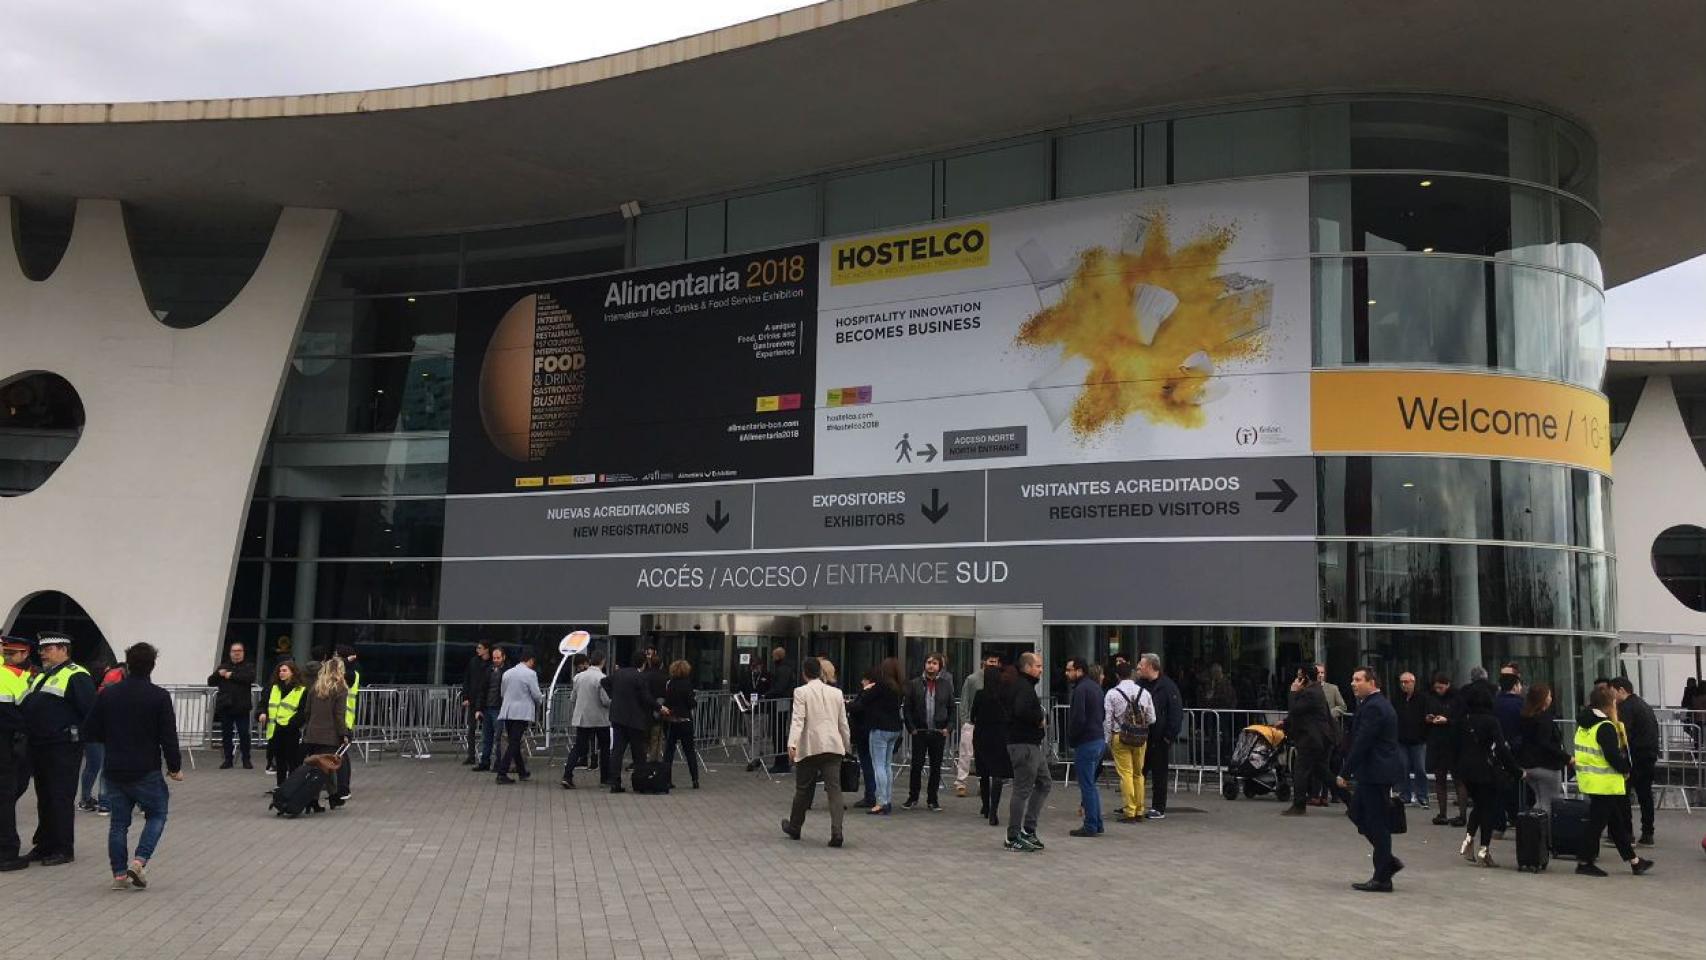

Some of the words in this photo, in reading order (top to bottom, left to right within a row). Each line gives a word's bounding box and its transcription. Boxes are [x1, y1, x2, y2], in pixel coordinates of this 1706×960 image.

[838, 229, 984, 271] HOSTELCO
[604, 266, 740, 307] Alimentaria
[746, 255, 804, 288] 2018
[604, 309, 649, 322] International
[675, 303, 700, 314] Drinks
[701, 301, 707, 310] &
[708, 298, 729, 308] Food
[731, 294, 760, 305] Service
[762, 289, 803, 301] Exhibition
[836, 310, 906, 328] HOSPITALITY
[909, 302, 981, 319] INNOVATION
[836, 325, 903, 344] BECOMES
[908, 316, 981, 336] BUSINESS
[534, 354, 585, 373] FOOD
[534, 373, 542, 387] &
[545, 371, 585, 386] DRINKS
[533, 384, 584, 396] GASTRONOMY
[533, 394, 583, 407] BUSINESS
[1397, 396, 1558, 441] Welcome
[1565, 409, 1573, 442] /
[954, 435, 986, 445] ACCESO
[988, 433, 1015, 442] NORTE
[1021, 481, 1110, 498] VISITANTES
[1115, 476, 1240, 494] ACREDITADOS
[812, 490, 906, 508] EXPOSITORES
[547, 506, 590, 520] NUEVAS
[593, 502, 690, 518] ACREDITACIONES
[1049, 501, 1153, 520] REGISTERED
[1157, 500, 1240, 517] VISITORS
[573, 524, 598, 538] NEW
[601, 522, 689, 537] REGISTRATIONS
[824, 513, 905, 529] EXHIBITORS
[637, 563, 704, 588] ACCÉS
[709, 567, 717, 589] /
[720, 565, 807, 588] ACCESO
[812, 563, 821, 588] /
[826, 561, 949, 586] ENTRANCE
[955, 560, 1009, 584] SUD
